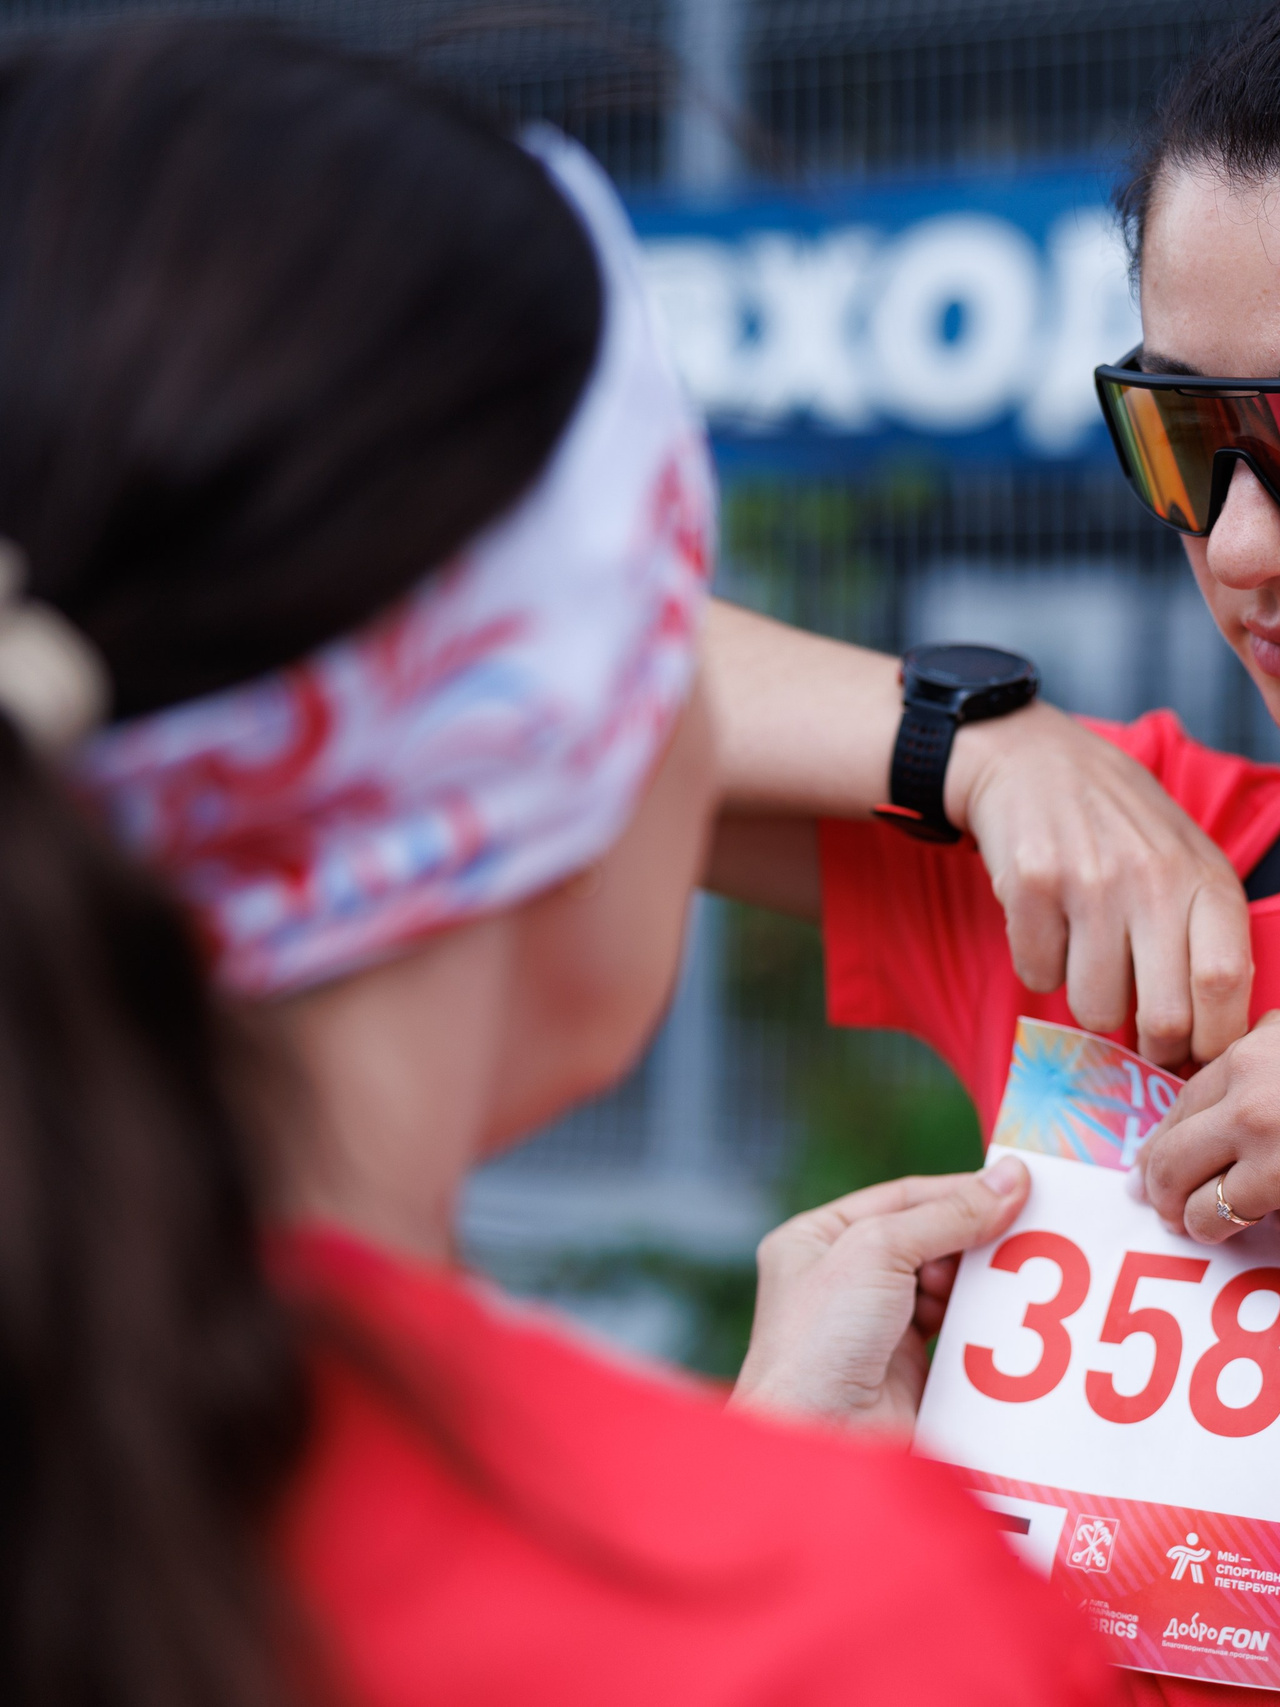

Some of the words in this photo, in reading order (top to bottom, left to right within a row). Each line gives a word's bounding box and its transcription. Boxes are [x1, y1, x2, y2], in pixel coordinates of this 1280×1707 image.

[1122, 1059, 1176, 1116] 10
[1161, 1640, 1229, 1657] Благотворительная
[1229, 1649, 1269, 1663] программа
